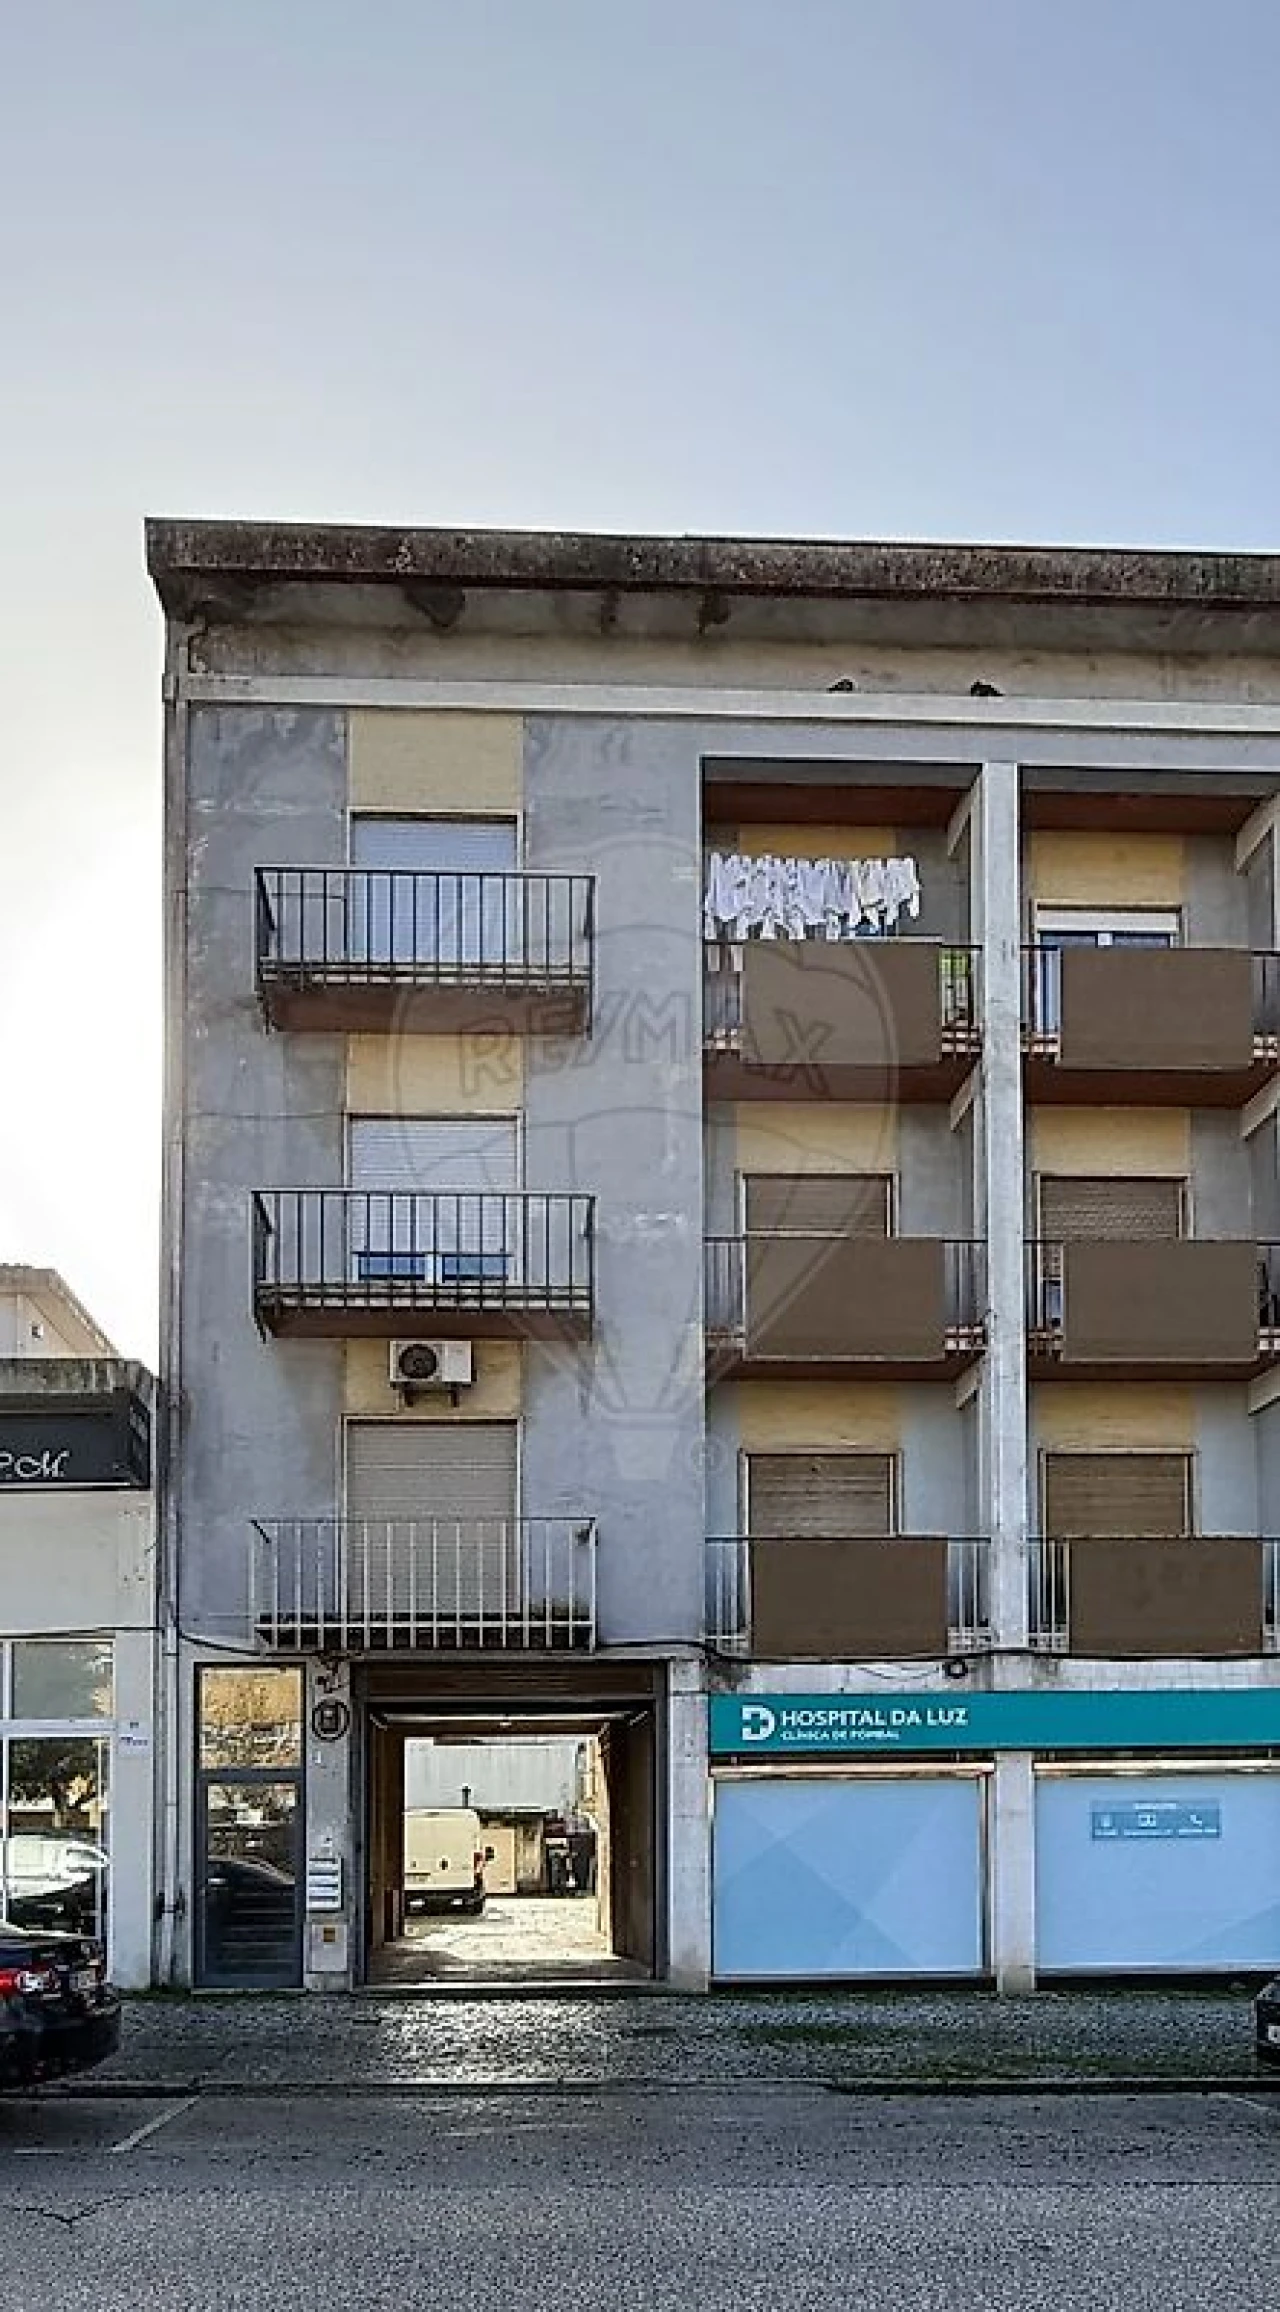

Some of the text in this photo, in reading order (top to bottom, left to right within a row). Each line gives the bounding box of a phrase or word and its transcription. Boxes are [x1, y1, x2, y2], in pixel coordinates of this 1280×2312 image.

[781, 1707, 969, 1726] HOSPITAL DA LUZ
[832, 1729, 848, 1741] DE
